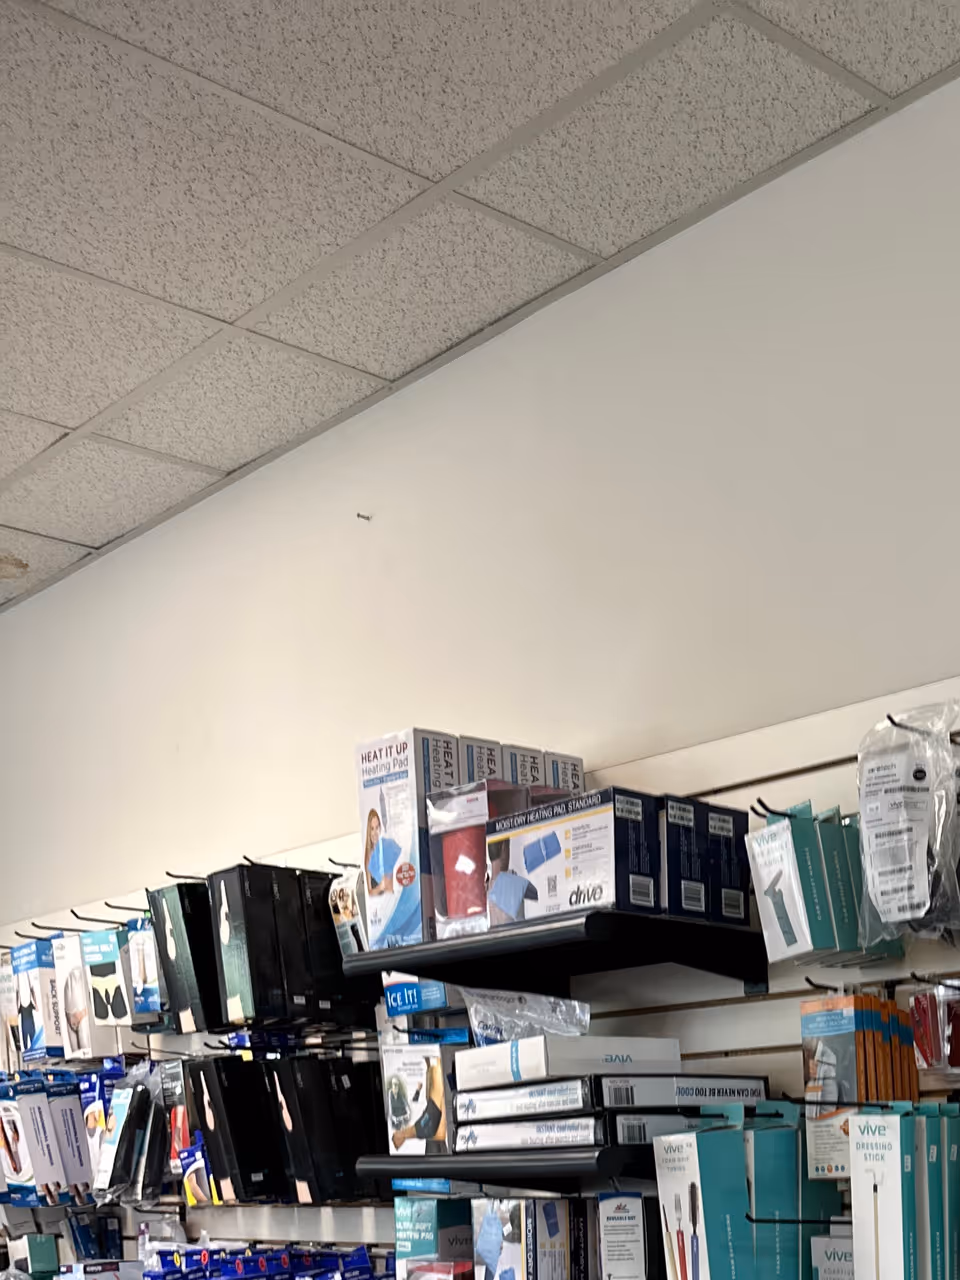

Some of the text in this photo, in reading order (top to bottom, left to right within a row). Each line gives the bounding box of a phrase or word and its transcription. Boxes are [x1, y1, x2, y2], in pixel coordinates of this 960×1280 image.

[361, 742, 408, 764] HEAT IT UP
[432, 738, 441, 787] Heating
[443, 740, 453, 780] HEAT
[487, 747, 496, 776] HEA
[362, 756, 408, 778] Heating Pad
[530, 756, 539, 784] HEA
[571, 763, 580, 792] HEA
[528, 805, 553, 826] HEATING
[568, 796, 601, 814] STANDARD
[569, 883, 604, 906] drive
[387, 990, 402, 1008] ICE
[695, 1087, 707, 1096] TOO
[708, 1087, 716, 1096] BE
[716, 1087, 735, 1097] NEVER
[737, 1087, 749, 1097] CAN
[858, 1121, 886, 1136] vive
[856, 1142, 892, 1151] DRESSING
[864, 1153, 885, 1161] STICK
[825, 1248, 852, 1262] vive
